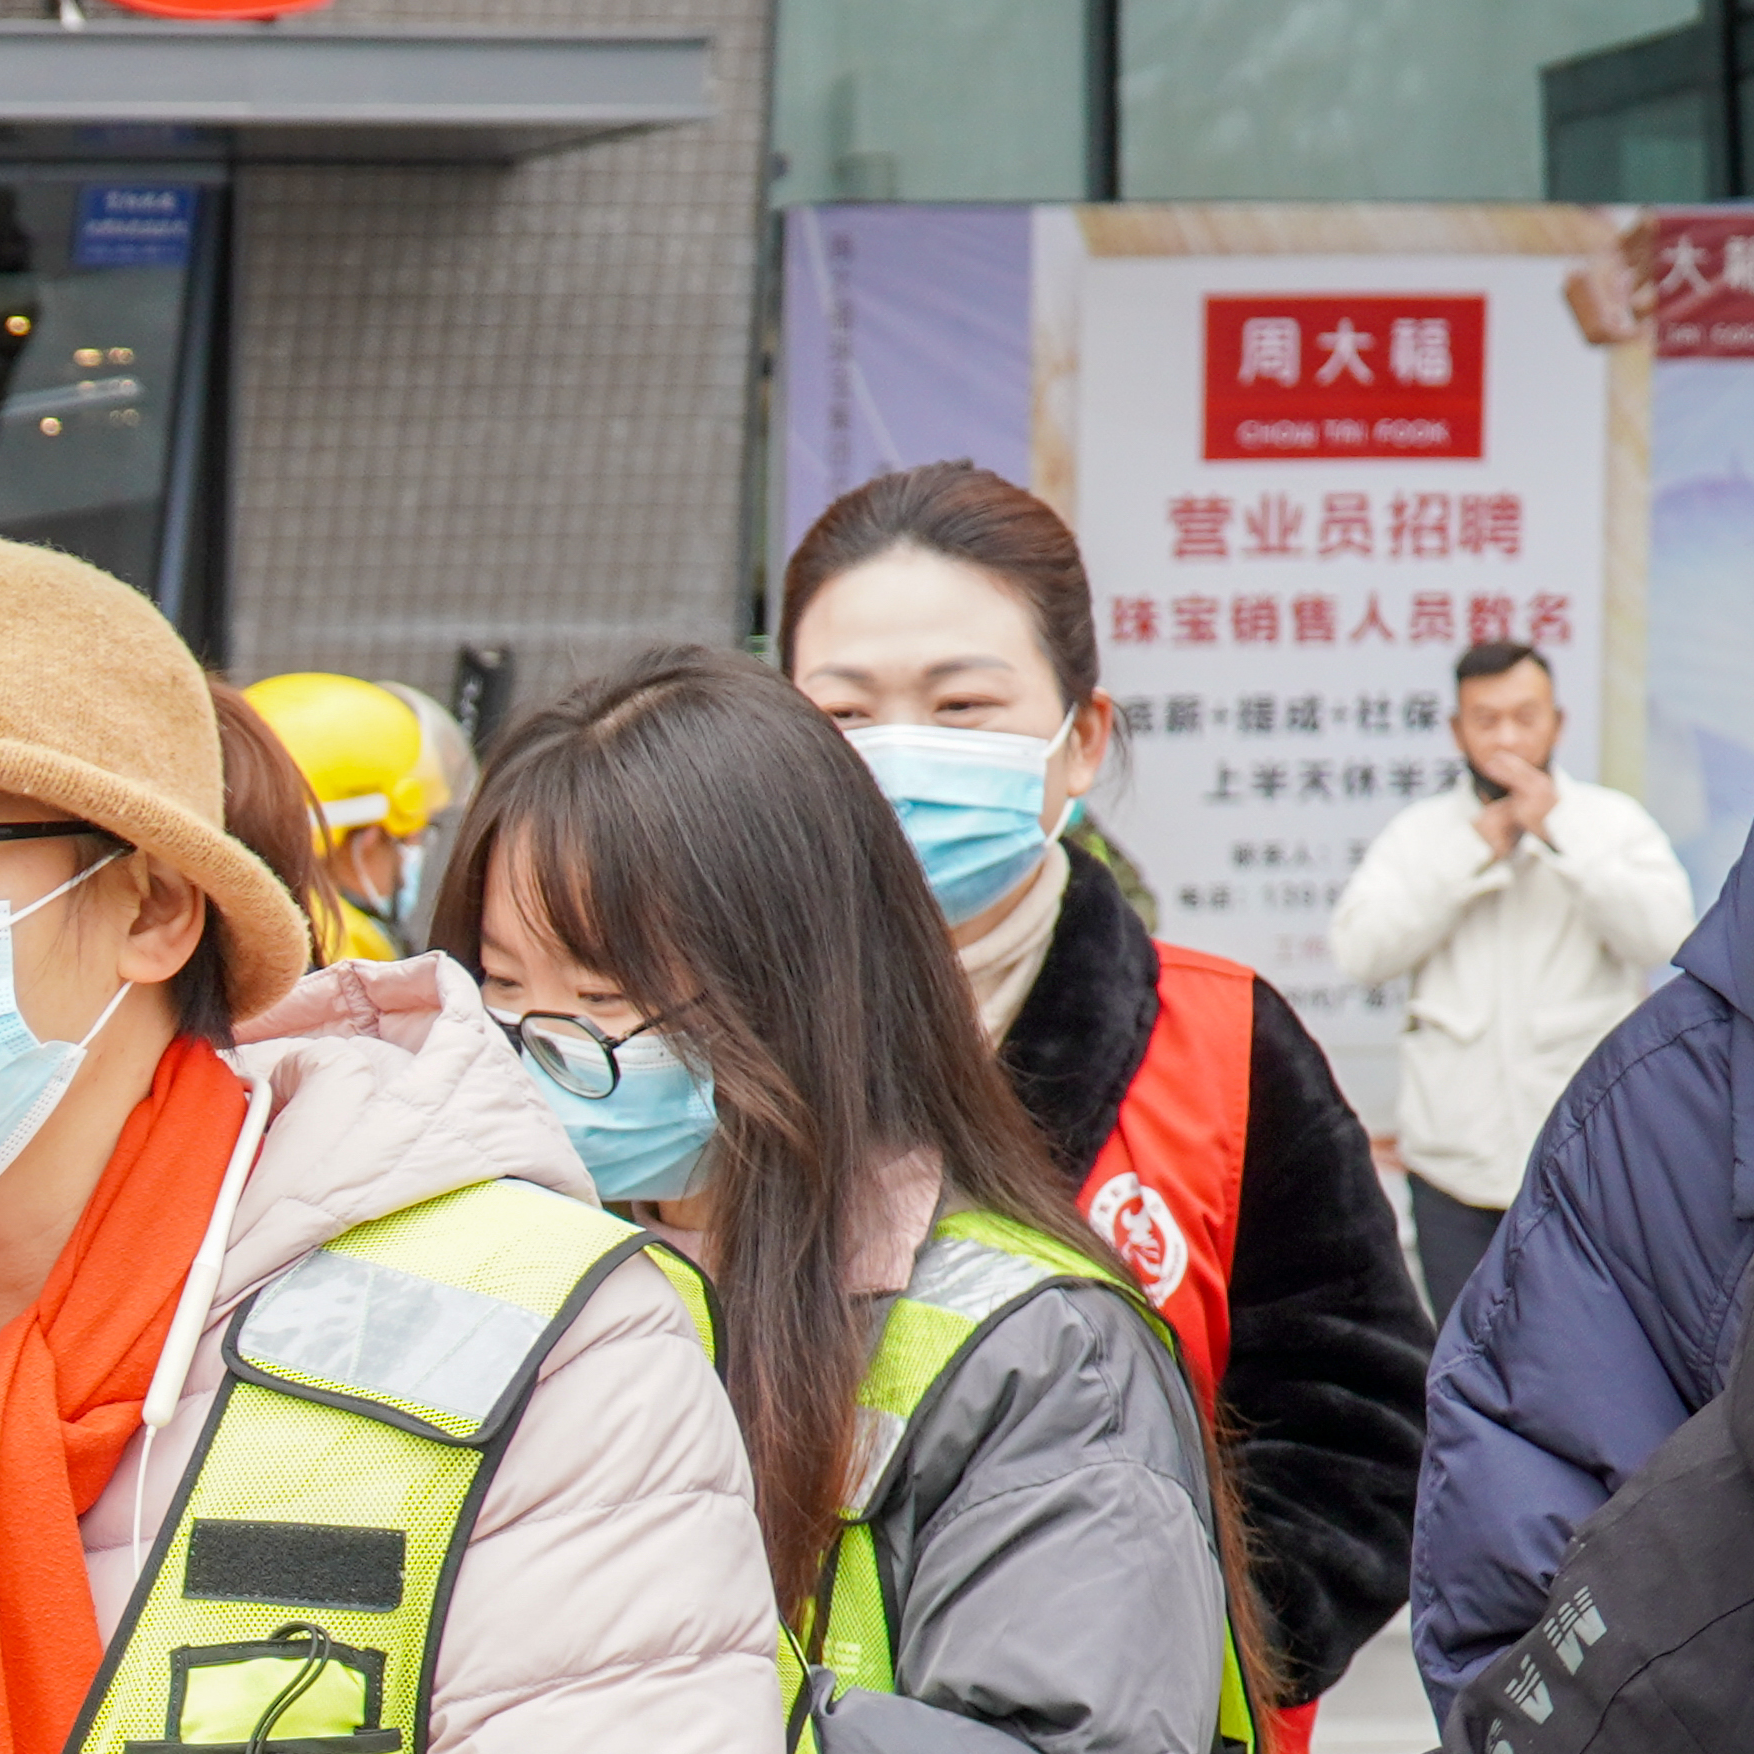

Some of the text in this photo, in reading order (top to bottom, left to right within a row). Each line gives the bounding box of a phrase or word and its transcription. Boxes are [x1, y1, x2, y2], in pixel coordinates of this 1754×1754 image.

[1238, 317, 1452, 388] 周大福
[1235, 417, 1451, 449] CHOW TAI FOOK
[1168, 491, 1524, 559] 营业员招聘
[1110, 591, 1574, 649] 珠宝销售人员数名
